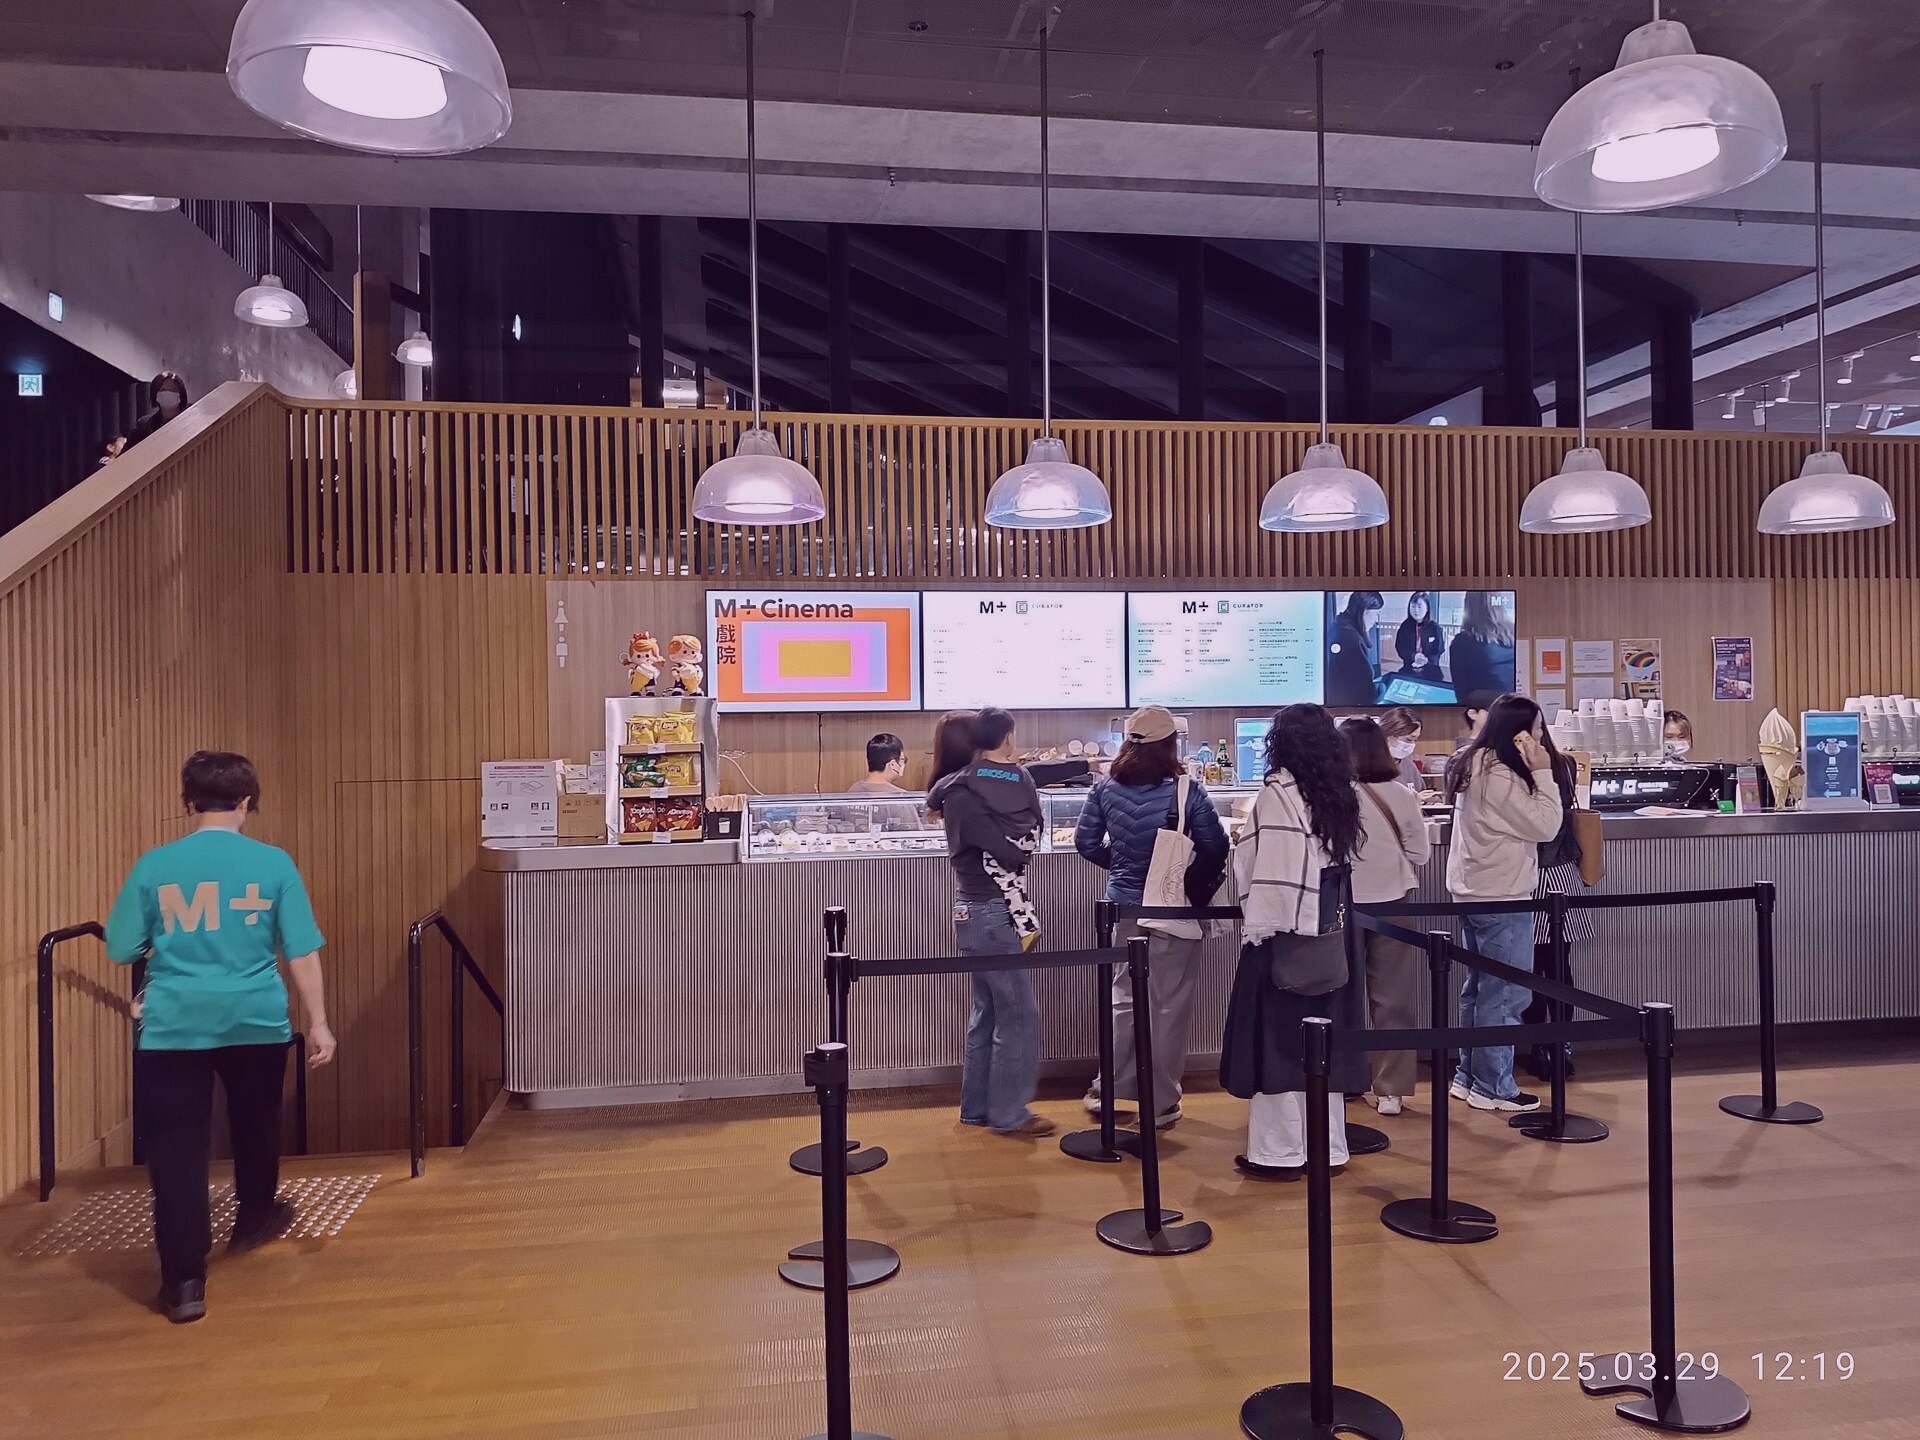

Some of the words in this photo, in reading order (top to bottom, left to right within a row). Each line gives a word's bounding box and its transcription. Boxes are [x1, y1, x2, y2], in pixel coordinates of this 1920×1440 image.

[714, 598, 756, 618] M+
[760, 598, 854, 618] Cinema
[979, 601, 1007, 613] M+
[1182, 601, 1209, 613] M+
[1490, 596, 1510, 607] M+
[1590, 780, 1620, 796] M+
[157, 880, 274, 935] M+
